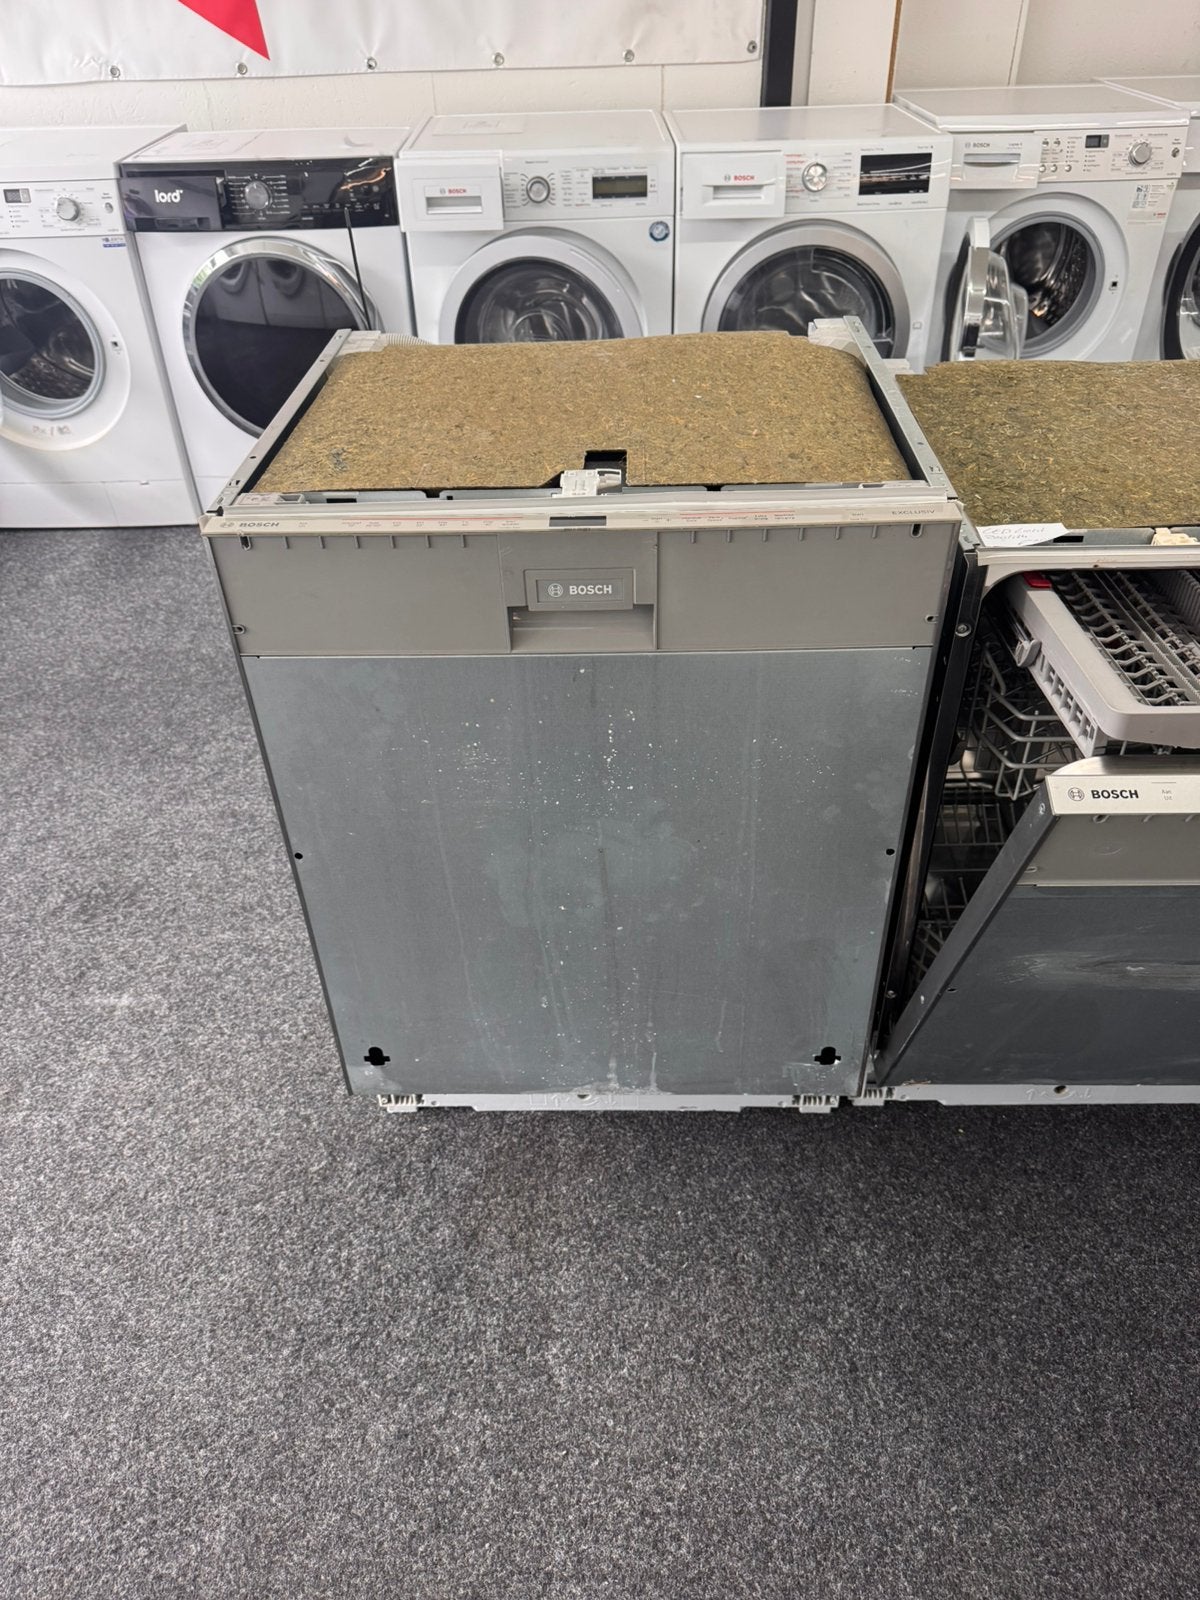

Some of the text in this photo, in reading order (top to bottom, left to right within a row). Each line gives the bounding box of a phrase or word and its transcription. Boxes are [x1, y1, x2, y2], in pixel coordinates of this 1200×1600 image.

[154, 189, 181, 203] lord
[569, 585, 612, 595] BOSCH
[1091, 789, 1139, 799] BOSCH
